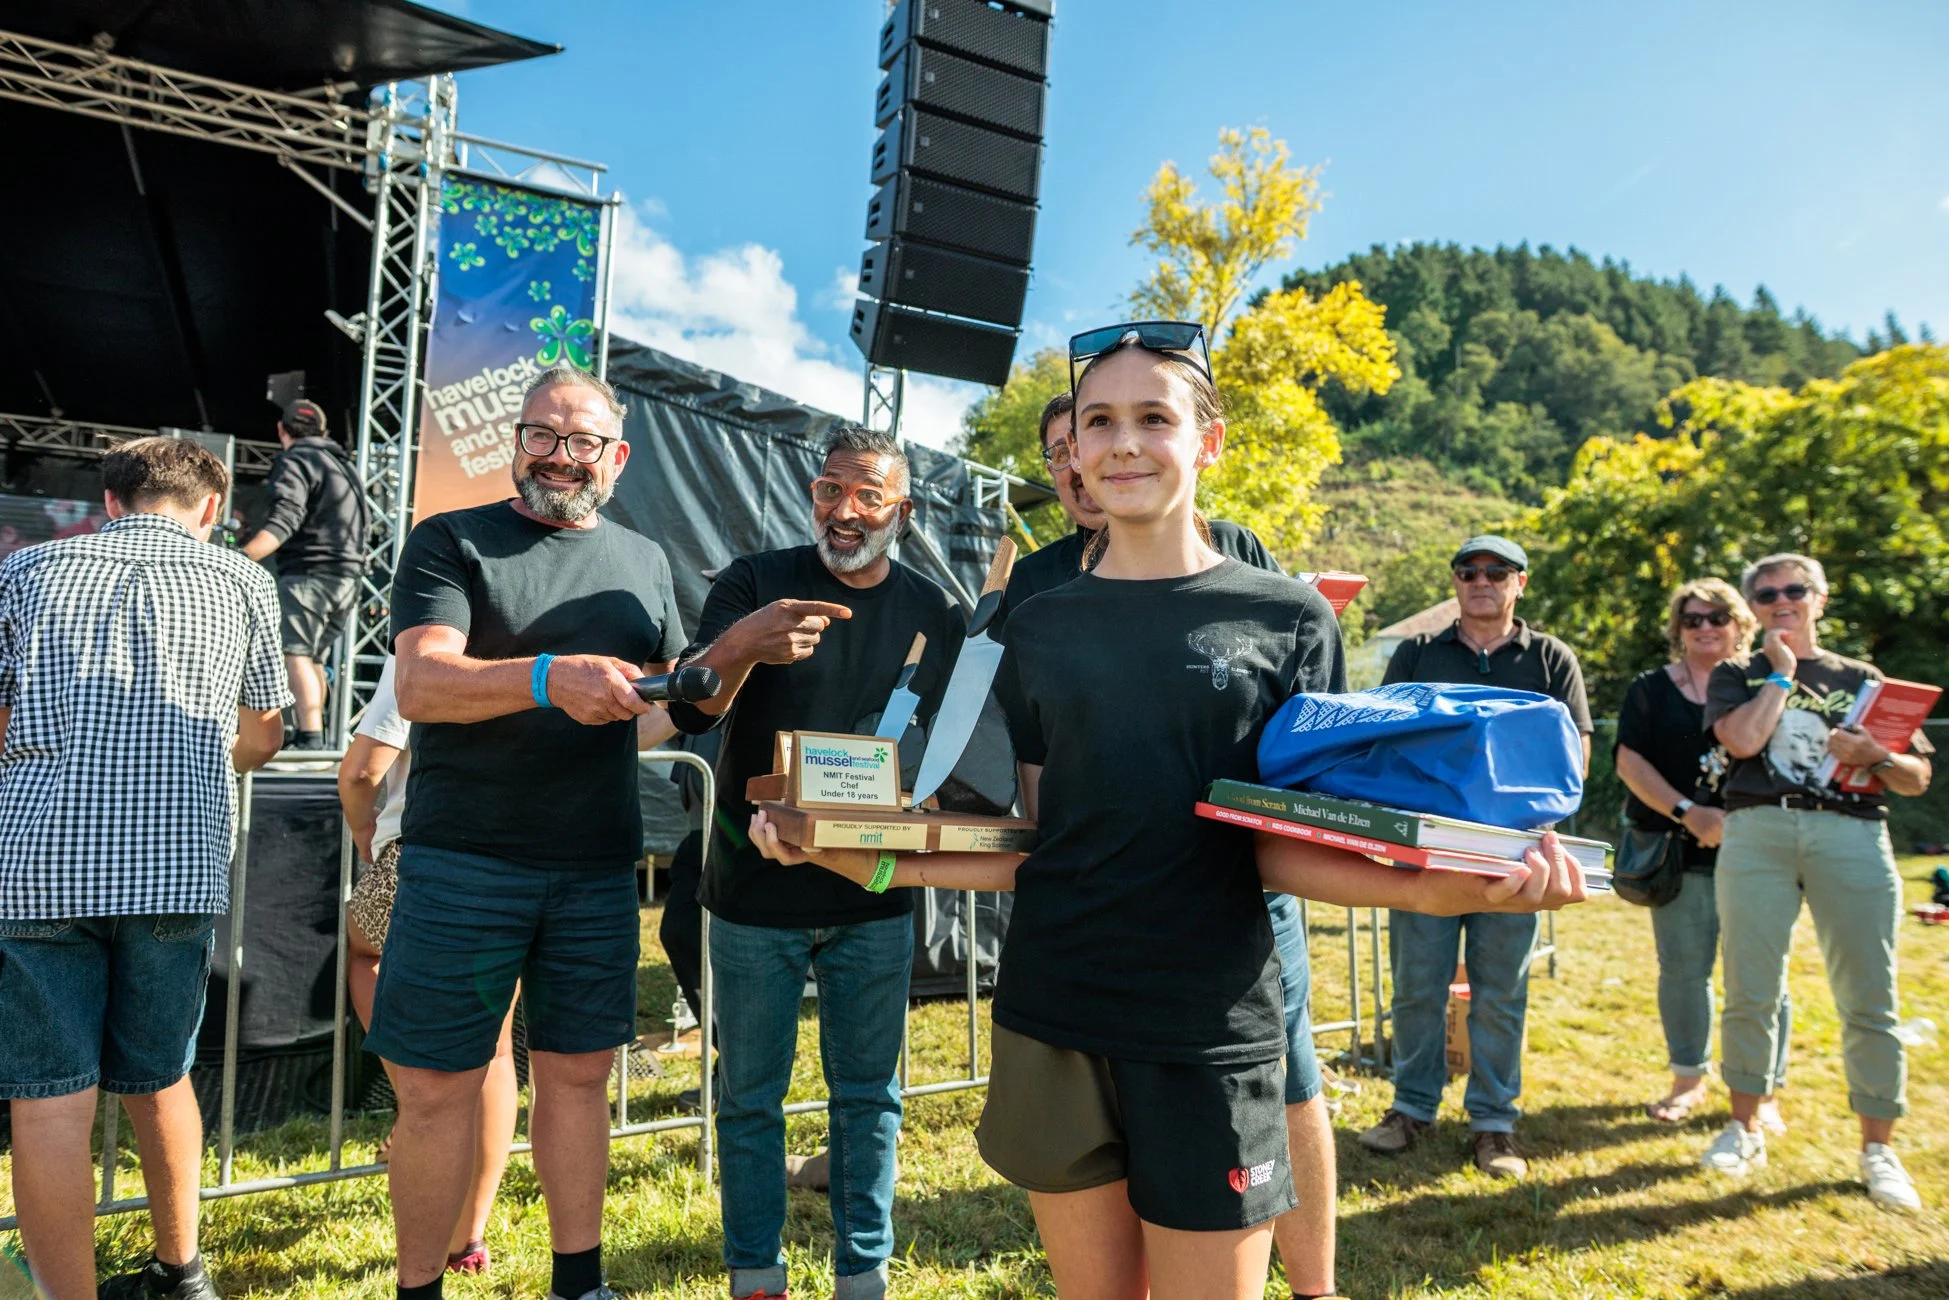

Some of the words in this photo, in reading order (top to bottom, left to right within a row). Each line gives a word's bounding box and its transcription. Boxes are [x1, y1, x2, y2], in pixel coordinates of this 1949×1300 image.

[423, 355, 541, 410] havelock
[434, 377, 532, 436] mus
[450, 422, 499, 457] and
[460, 440, 516, 479] festi
[805, 746, 849, 757] havelock
[805, 755, 852, 767] mussel
[852, 761, 880, 769] festival
[823, 771, 843, 780] NMIT
[845, 773, 875, 781] Festival
[840, 781, 859, 790] Chef
[821, 789, 845, 798] Under
[1262, 798, 1287, 812] Scratch
[1293, 803, 1320, 818] Michael
[1321, 808, 1336, 822] Van
[1337, 812, 1348, 824] de
[1348, 813, 1371, 828] Elzen
[860, 832, 882, 844] nmit
[1216, 810, 1229, 819] GOOD
[1229, 813, 1243, 822] FROM
[1243, 815, 1262, 826] SCRATCH
[1272, 822, 1283, 831] KIDS
[1283, 824, 1312, 837] COOKBOOK
[1323, 833, 1346, 844] MICHAEL
[1347, 838, 1359, 847] VAN
[1359, 841, 1367, 849] DE
[1367, 842, 1387, 853] ELZEN
[1250, 1159, 1276, 1177] STONEY
[1250, 1171, 1273, 1187] CREEK
